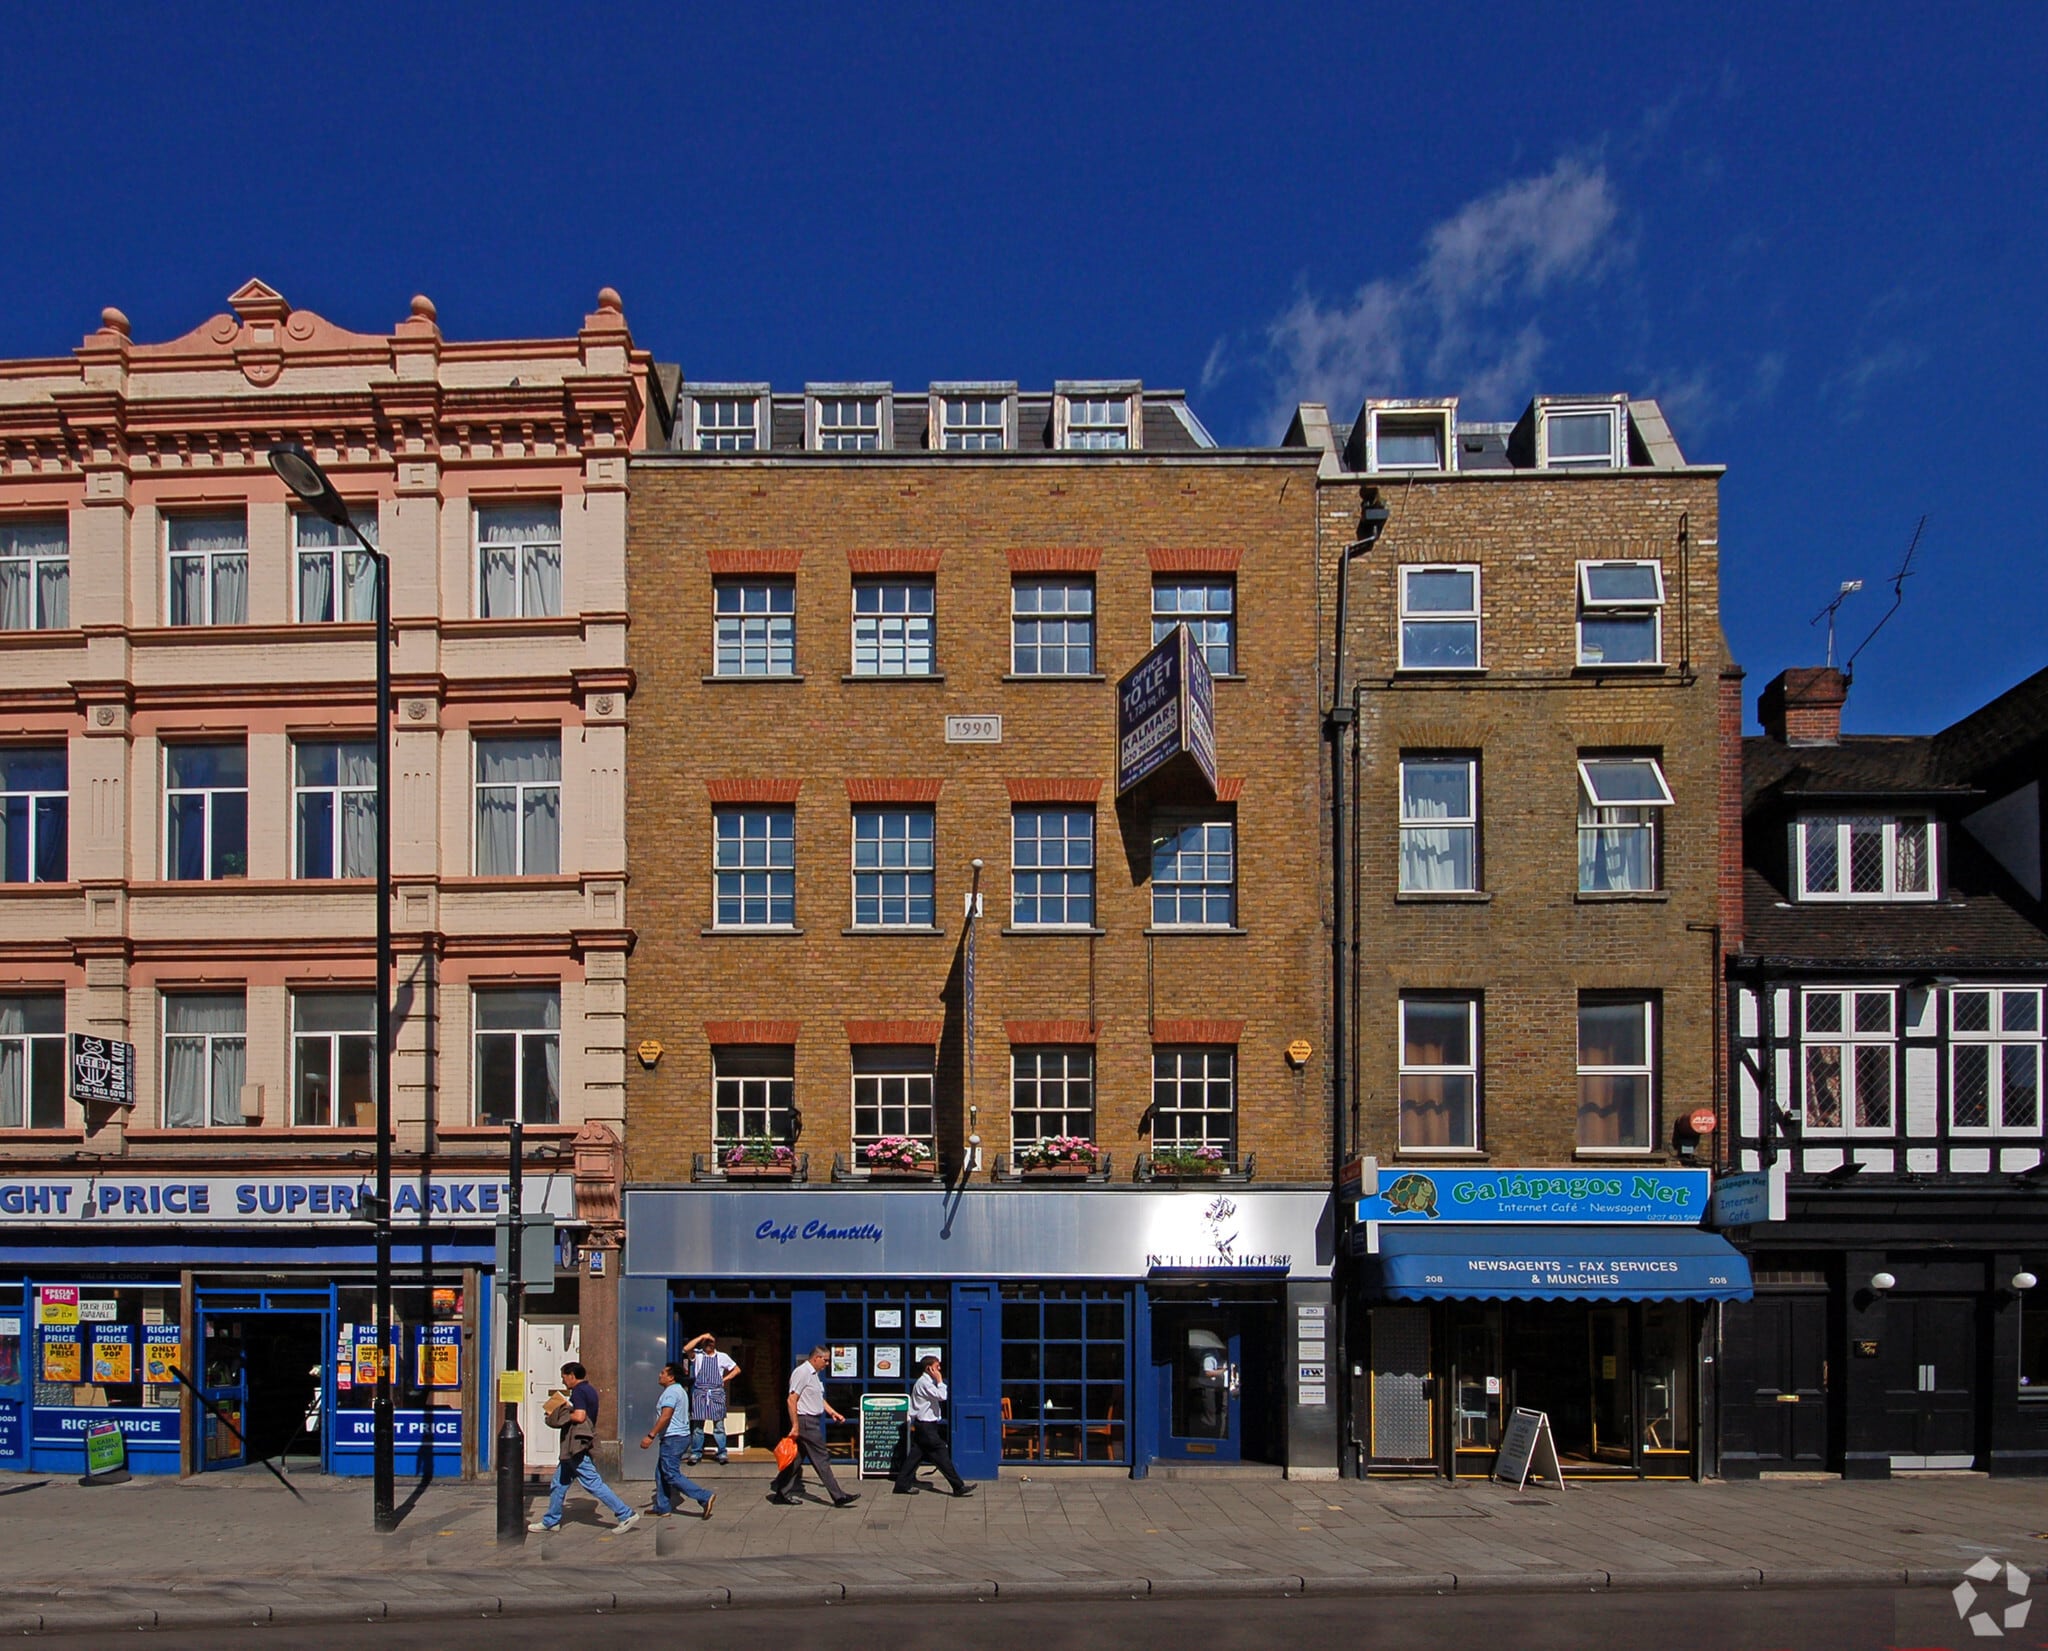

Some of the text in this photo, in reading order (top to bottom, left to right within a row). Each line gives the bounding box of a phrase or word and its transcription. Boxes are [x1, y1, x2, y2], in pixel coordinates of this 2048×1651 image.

[1132, 653, 1163, 687] OFFICE
[1122, 657, 1173, 713] TO LET
[954, 721, 992, 736] 1990
[1123, 704, 1177, 753] KALMARS
[1123, 750, 1138, 767] 020
[111, 1041, 125, 1090] BLACK KATZ
[1453, 1174, 1690, 1206] Galápagos Net
[99, 1185, 210, 1215] PRICE
[236, 1184, 523, 1213] SUPERARKE
[1498, 1202, 1547, 1212] Internet
[1552, 1202, 1578, 1212] Café
[1590, 1202, 1652, 1215] Newsagent
[755, 1219, 883, 1244] Café Chantilly
[1238, 1254, 1292, 1267] HOUSE
[1468, 1261, 1561, 1272] NEWSAGENTS
[1579, 1261, 1604, 1272] FAX
[1611, 1261, 1678, 1272] SERVICES
[1425, 1275, 1443, 1283] 208
[1531, 1274, 1619, 1285] & MUNCHIES
[1708, 1276, 1727, 1285] 208
[44, 1325, 77, 1333] RIGHT
[95, 1325, 128, 1333] RIGHT
[146, 1326, 180, 1334] RIGHT
[421, 1326, 455, 1334] RIGHT
[44, 1335, 76, 1343] PRICE
[96, 1335, 128, 1343] PRICE
[147, 1336, 179, 1344] PRICE
[422, 1336, 454, 1344] PRICE
[354, 1422, 457, 1434] RIT PRICE
[864, 1460, 892, 1469] TAKEAW
